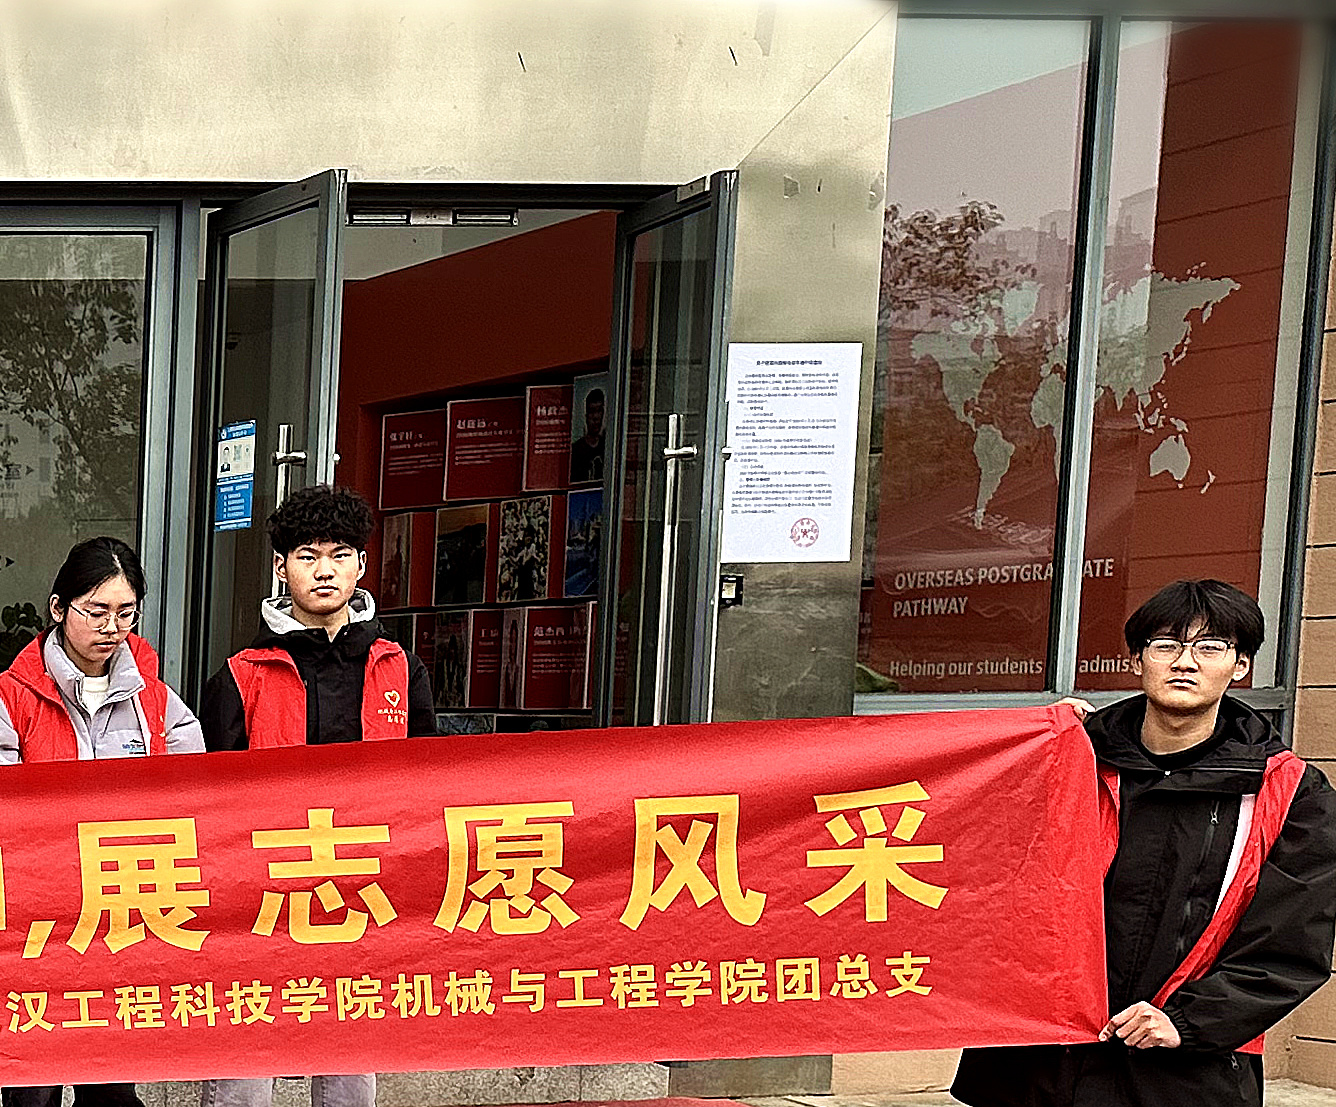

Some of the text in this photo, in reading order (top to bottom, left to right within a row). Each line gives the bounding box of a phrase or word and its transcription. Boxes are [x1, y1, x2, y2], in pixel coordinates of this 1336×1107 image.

[894, 557, 1115, 591] OVERSEAS POSTGRAATE
[893, 596, 968, 618] PATHWAY
[890, 659, 945, 679] Helping
[948, 661, 973, 676] our
[977, 656, 1043, 675] students
